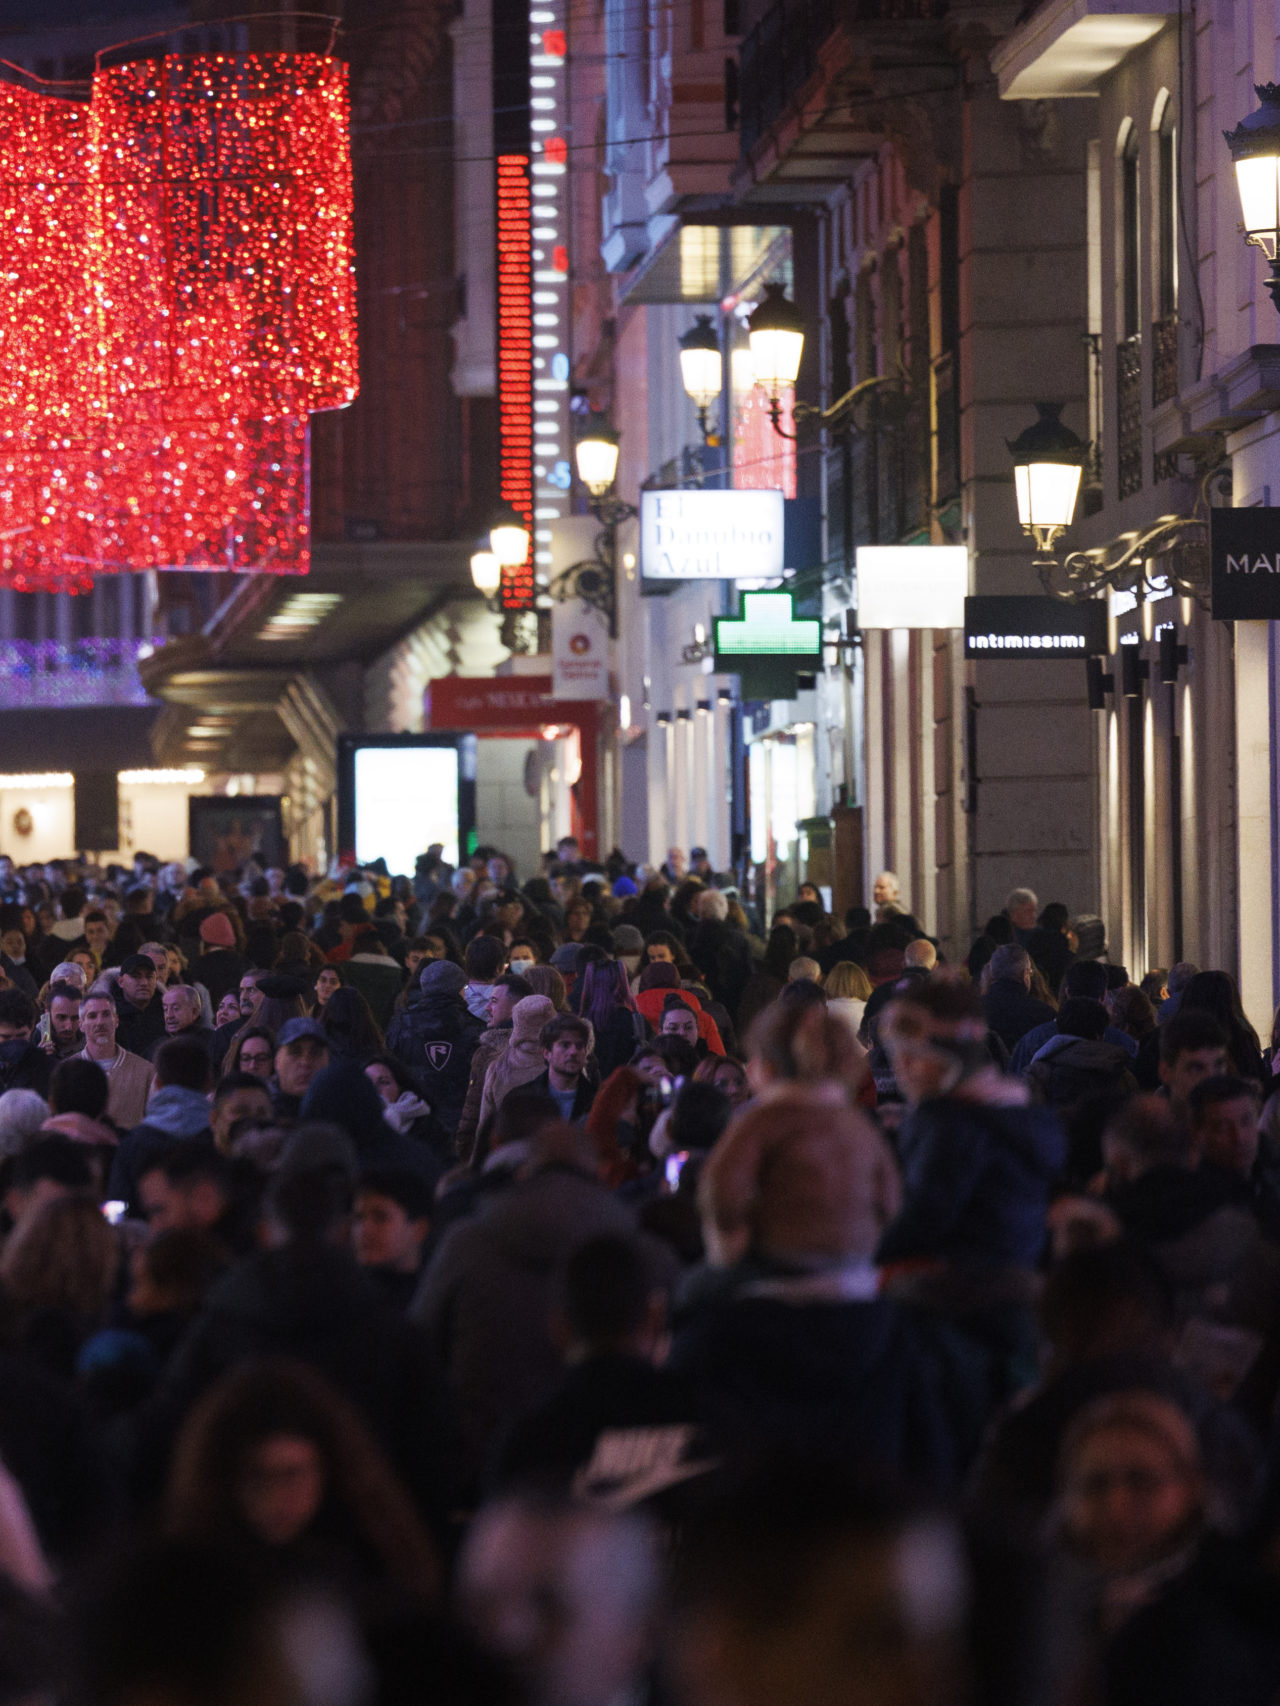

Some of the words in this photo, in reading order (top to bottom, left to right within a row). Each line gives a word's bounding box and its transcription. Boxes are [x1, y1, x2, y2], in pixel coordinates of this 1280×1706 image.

[655, 496, 683, 519] El
[655, 524, 773, 546] Danubio
[655, 552, 721, 574] Azul
[1226, 553, 1280, 574] MA
[968, 632, 1086, 649] intimissimi
